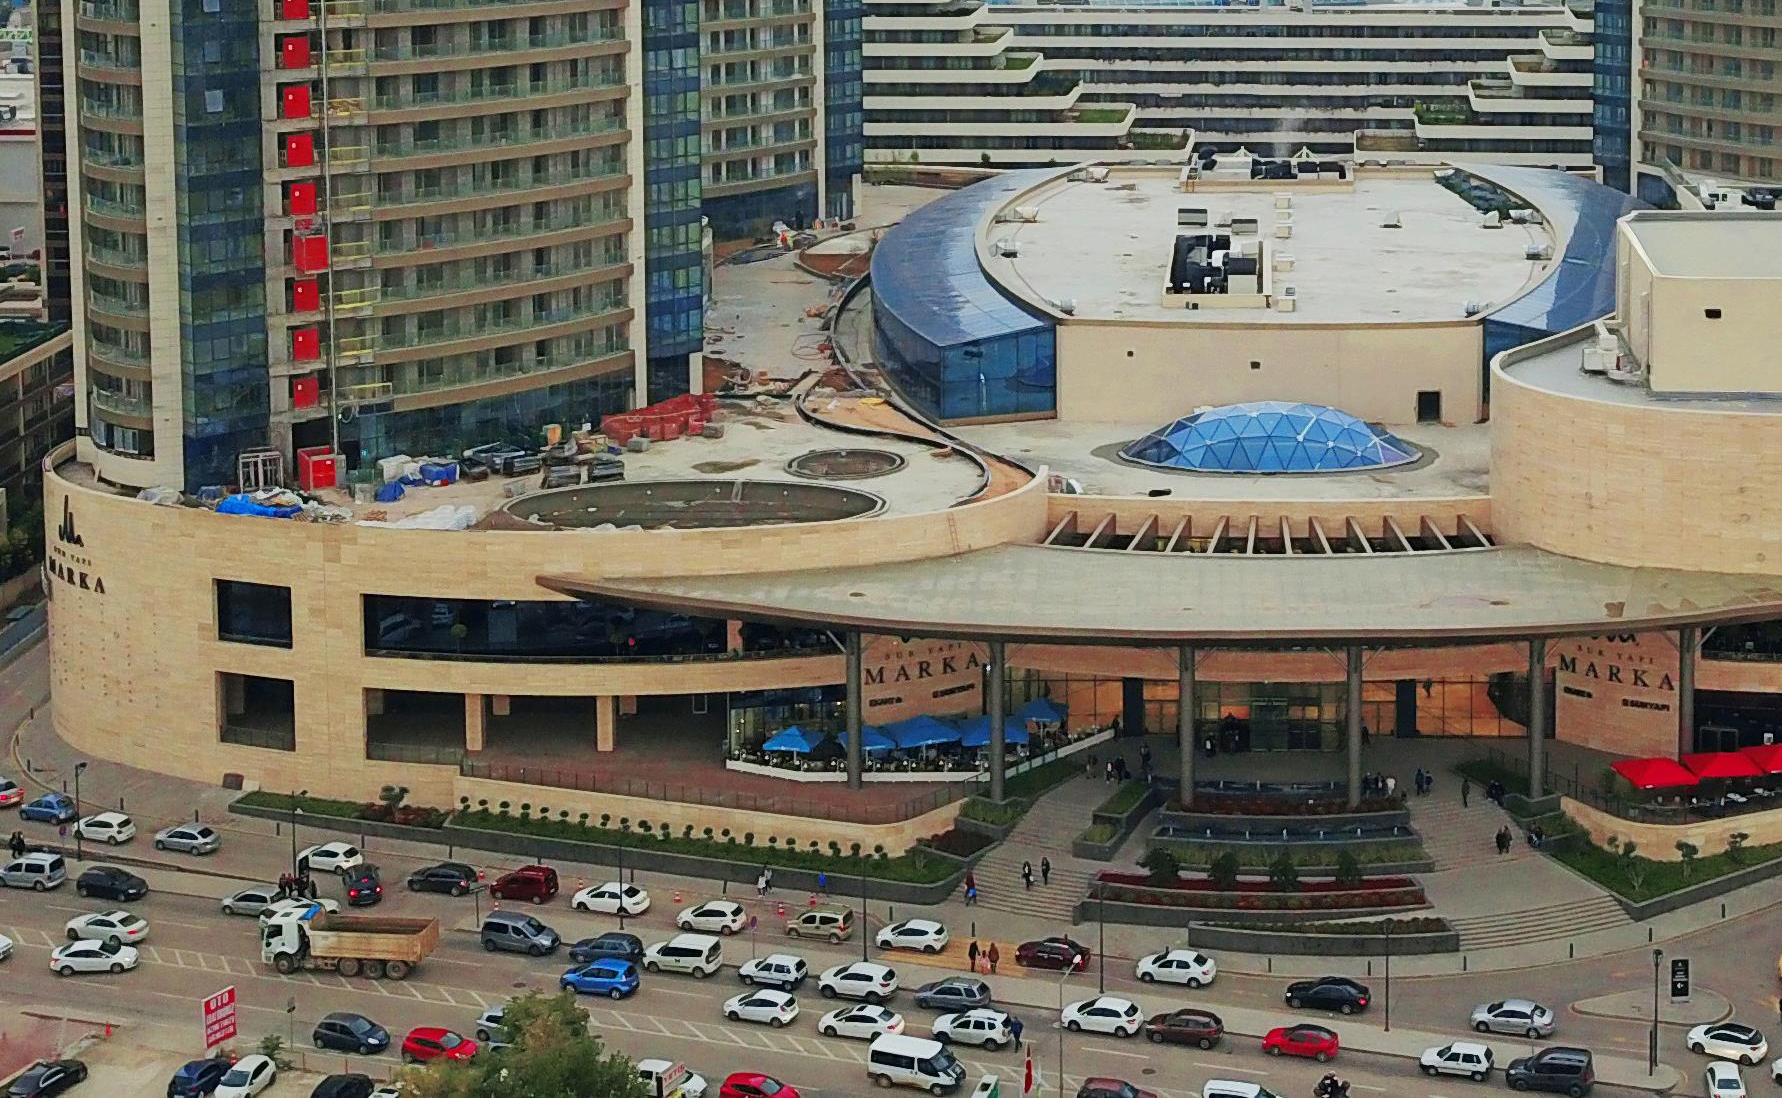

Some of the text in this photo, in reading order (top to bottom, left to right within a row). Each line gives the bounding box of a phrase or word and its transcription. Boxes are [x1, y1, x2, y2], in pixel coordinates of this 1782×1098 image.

[49, 555, 106, 595] MARKA
[863, 651, 980, 686] MARKA
[1560, 654, 1675, 691] MARKA
[210, 992, 229, 1011] OTO
